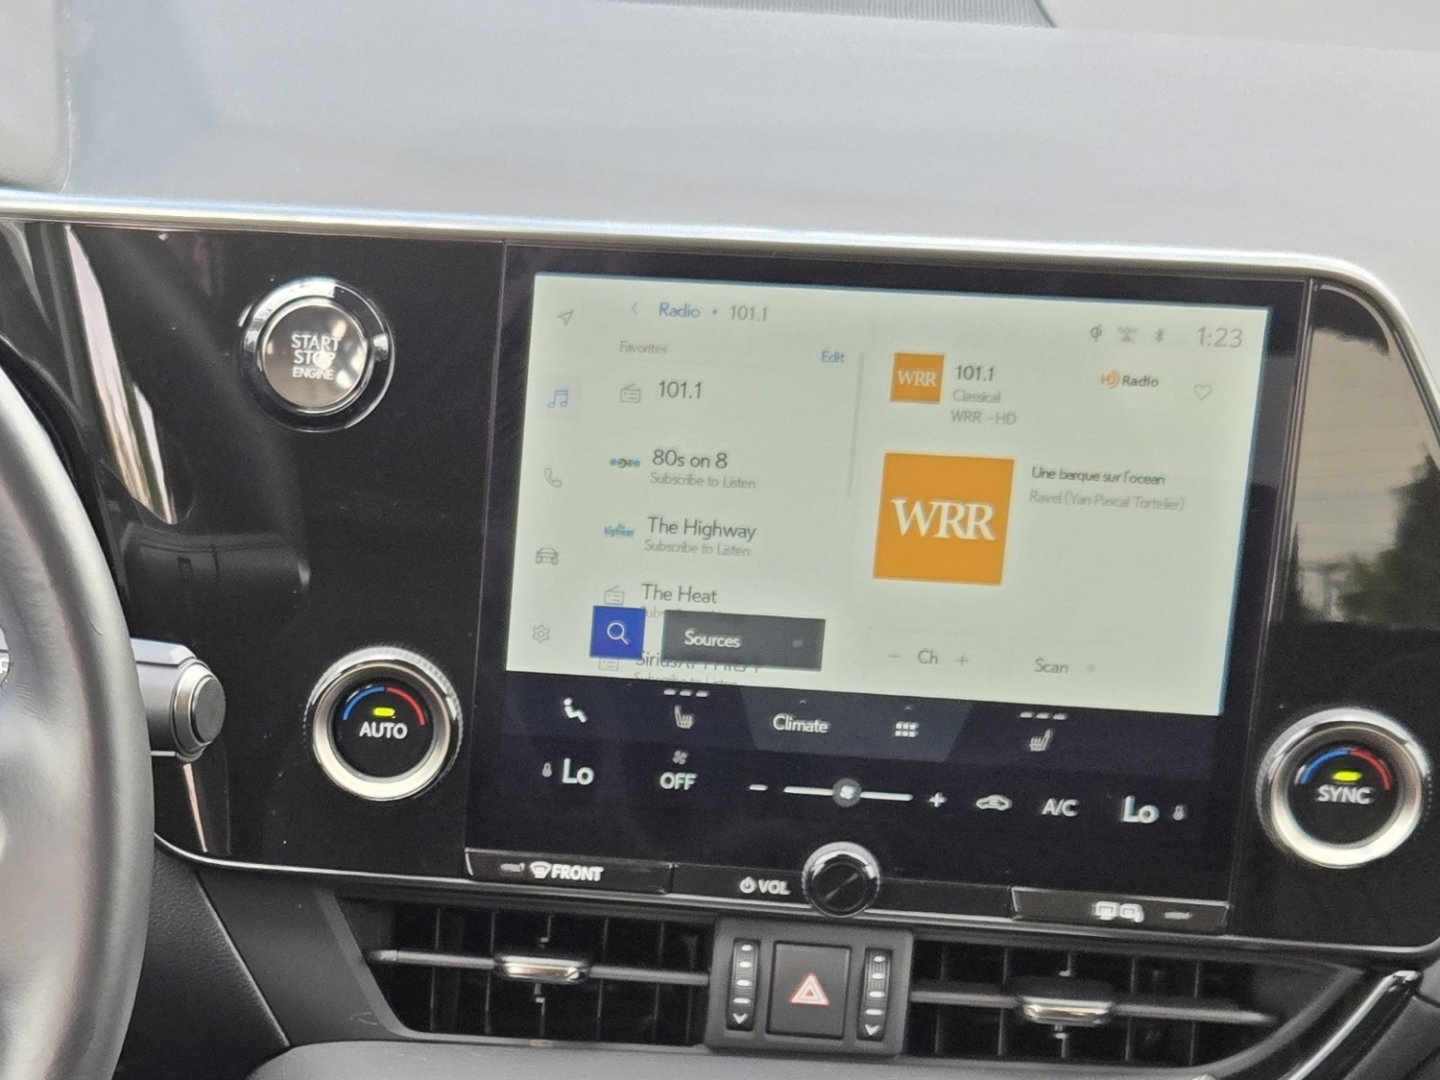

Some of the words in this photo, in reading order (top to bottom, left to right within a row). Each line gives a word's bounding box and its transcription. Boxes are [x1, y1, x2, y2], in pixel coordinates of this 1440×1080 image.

[659, 302, 700, 319] Radio
[730, 305, 768, 322] 101.1
[291, 334, 340, 351] START
[1197, 326, 1244, 349] 1:23
[620, 341, 667, 356] Favorites
[821, 350, 845, 364] Edit
[292, 367, 334, 380] ENGINE
[897, 369, 937, 388] WRR
[956, 365, 994, 382] 101.1
[1122, 373, 1159, 388] Radio
[658, 380, 703, 400] 101.1
[952, 389, 1001, 404] Classical
[951, 410, 982, 423] WRR
[652, 449, 685, 468] 80s
[690, 456, 710, 469] on
[715, 452, 728, 469] 8
[650, 471, 704, 486] Subscribe
[708, 476, 719, 488] to
[723, 476, 756, 489] Listen
[1032, 466, 1056, 480] Une
[1059, 468, 1100, 483] barque
[1103, 473, 1121, 483] sur
[891, 497, 996, 542] WRR
[648, 516, 678, 535] The
[683, 518, 757, 542] Highway
[644, 539, 698, 554] Subscribe
[702, 543, 713, 555] to
[717, 543, 750, 557] Listen
[641, 583, 673, 601] The
[678, 586, 718, 604] Heat
[684, 629, 741, 649] Sources
[918, 651, 939, 666] Ch
[1034, 658, 1069, 674] Scan
[359, 721, 408, 739] AUTO
[773, 714, 828, 734] Climate
[562, 758, 595, 785] Lo
[660, 772, 697, 790] OFF
[1317, 785, 1372, 805] SYNC
[1041, 798, 1080, 818] A/C
[1122, 796, 1158, 824] Lo
[551, 865, 604, 882] FRONT
[758, 879, 791, 896] VOL
